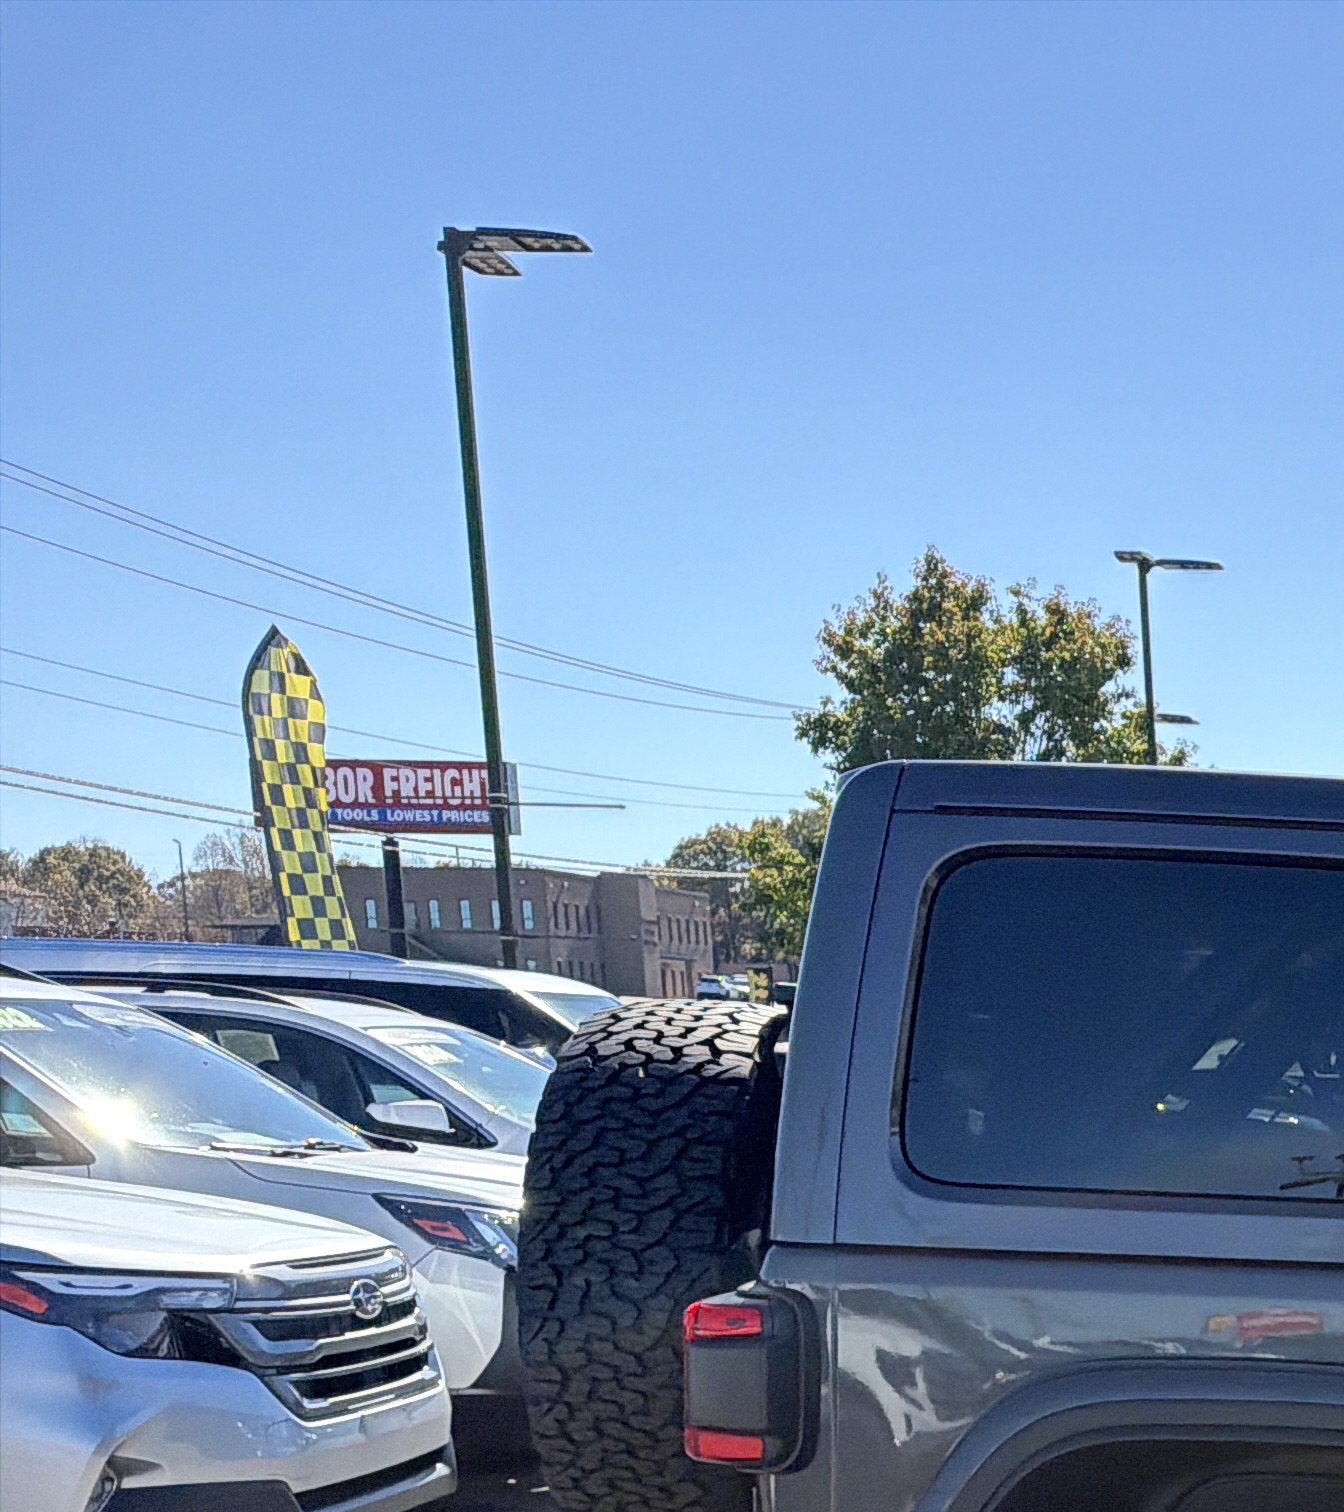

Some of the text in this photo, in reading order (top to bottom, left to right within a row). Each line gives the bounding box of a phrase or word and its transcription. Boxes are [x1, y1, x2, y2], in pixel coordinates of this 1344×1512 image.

[335, 808, 379, 821] TOOLS
[386, 809, 440, 822] LOWEST
[442, 809, 490, 823] PRICES
